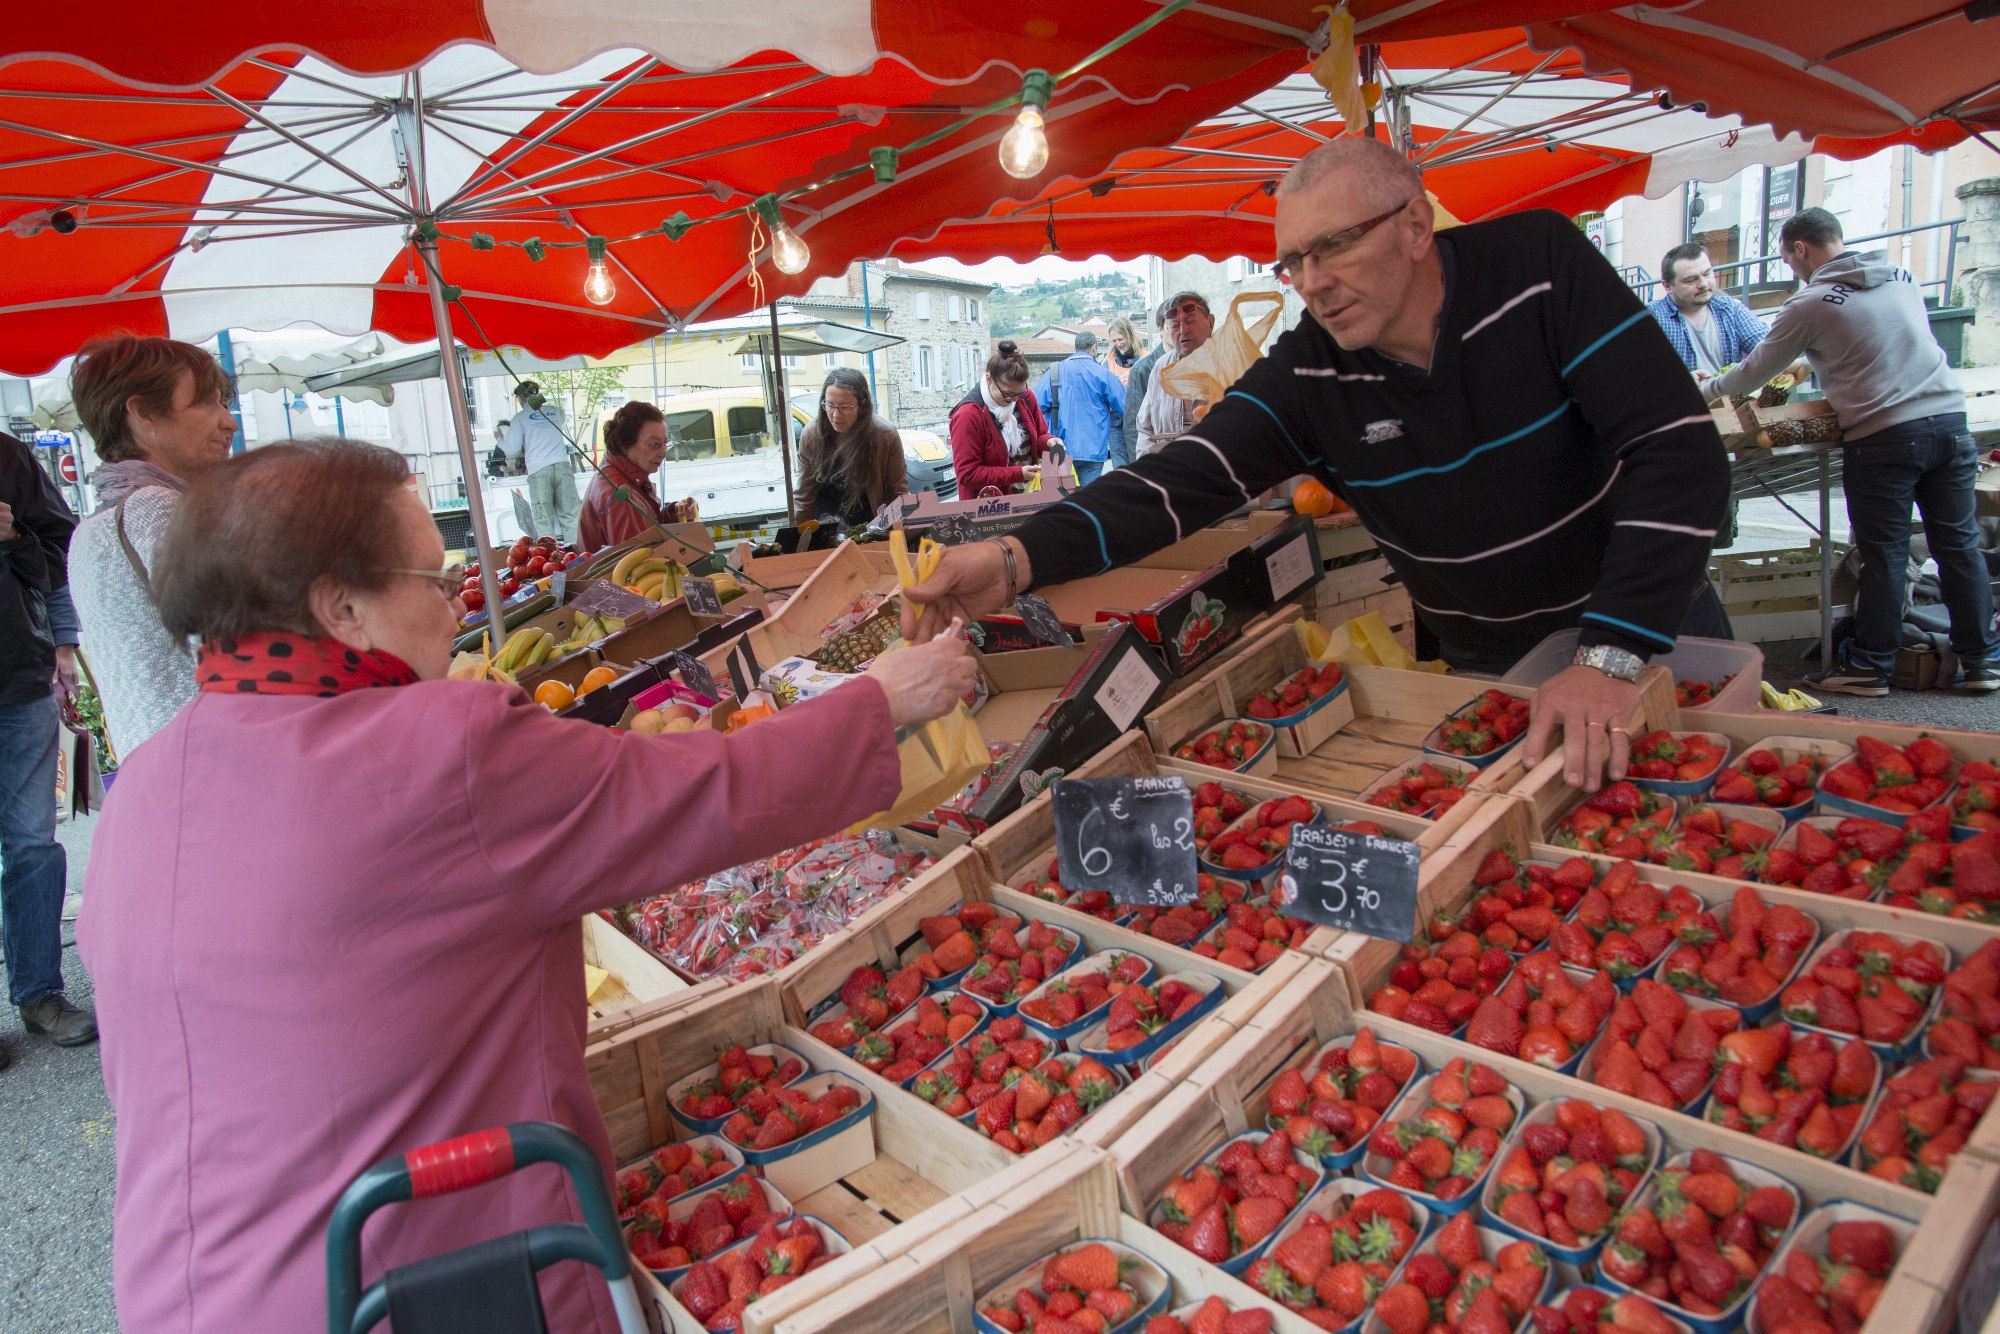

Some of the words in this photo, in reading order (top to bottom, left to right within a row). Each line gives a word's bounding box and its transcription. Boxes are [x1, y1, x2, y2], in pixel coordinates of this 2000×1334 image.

[1588, 221, 1603, 233] ZONE
[982, 525, 995, 533] aus
[1134, 776, 1182, 791] FRANCE
[1078, 806, 1113, 876] 6
[1108, 797, 1130, 820] €
[1173, 817, 1195, 851] 2
[1291, 823, 1348, 848] FRAISES
[1366, 834, 1414, 854] FRANCE
